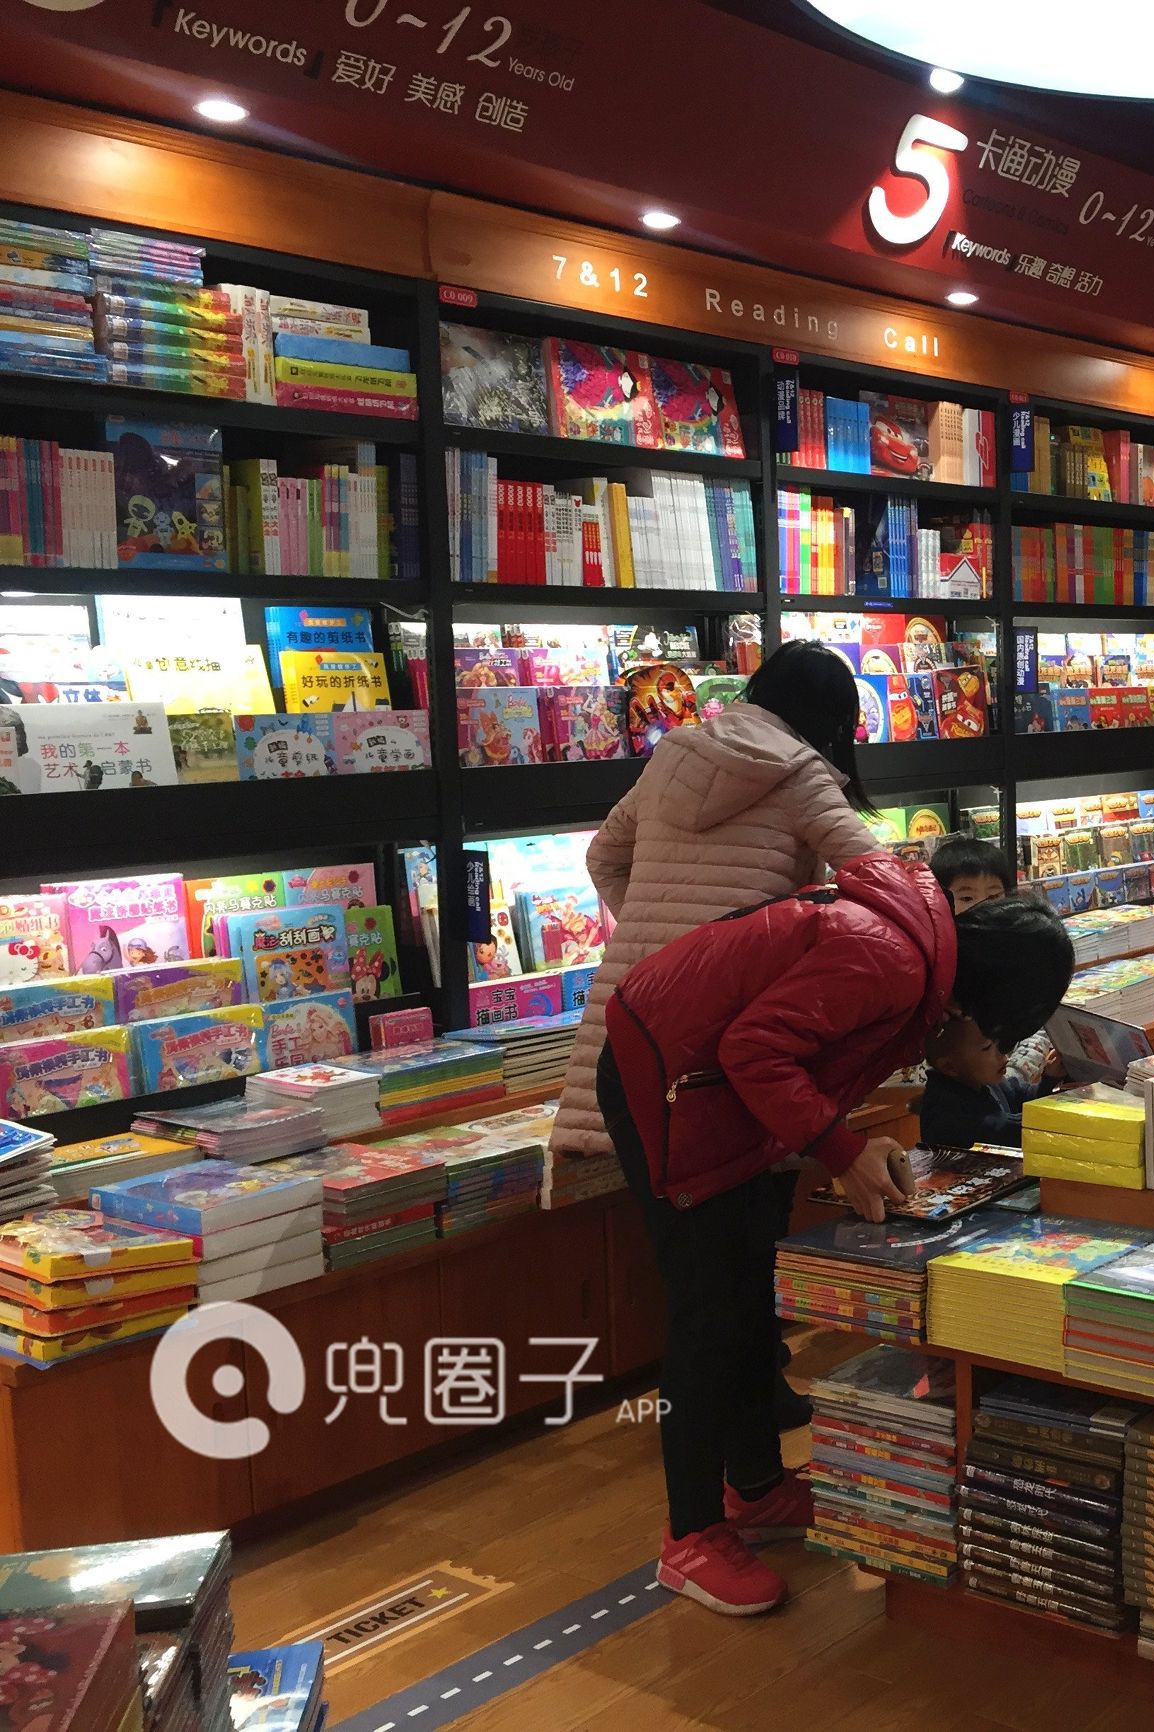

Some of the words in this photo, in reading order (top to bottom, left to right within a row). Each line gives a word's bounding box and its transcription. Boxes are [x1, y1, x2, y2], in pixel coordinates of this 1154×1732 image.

[174, 8, 308, 67] Keywords
[331, 50, 397, 94] 爱好
[405, 72, 465, 115] 美感
[475, 91, 530, 132] 创造
[507, 56, 544, 82] Years
[549, 71, 575, 91] Old
[868, 113, 969, 245] 5
[977, 128, 1081, 198] 卡通动漫
[951, 232, 1012, 265] Keywords
[1014, 253, 1045, 280] 乐趣
[1075, 270, 1103, 296] 活力
[706, 289, 839, 340] Reading
[884, 327, 940, 358] Call
[286, 631, 367, 645] 有趣的剪纸书
[302, 675, 382, 689] 好玩的折纸书
[40, 741, 131, 760] 我的第一本
[476, 1004, 518, 1025] 描画书
[492, 987, 516, 1003] 宝宝
[326, 1595, 424, 1646] TICKET
